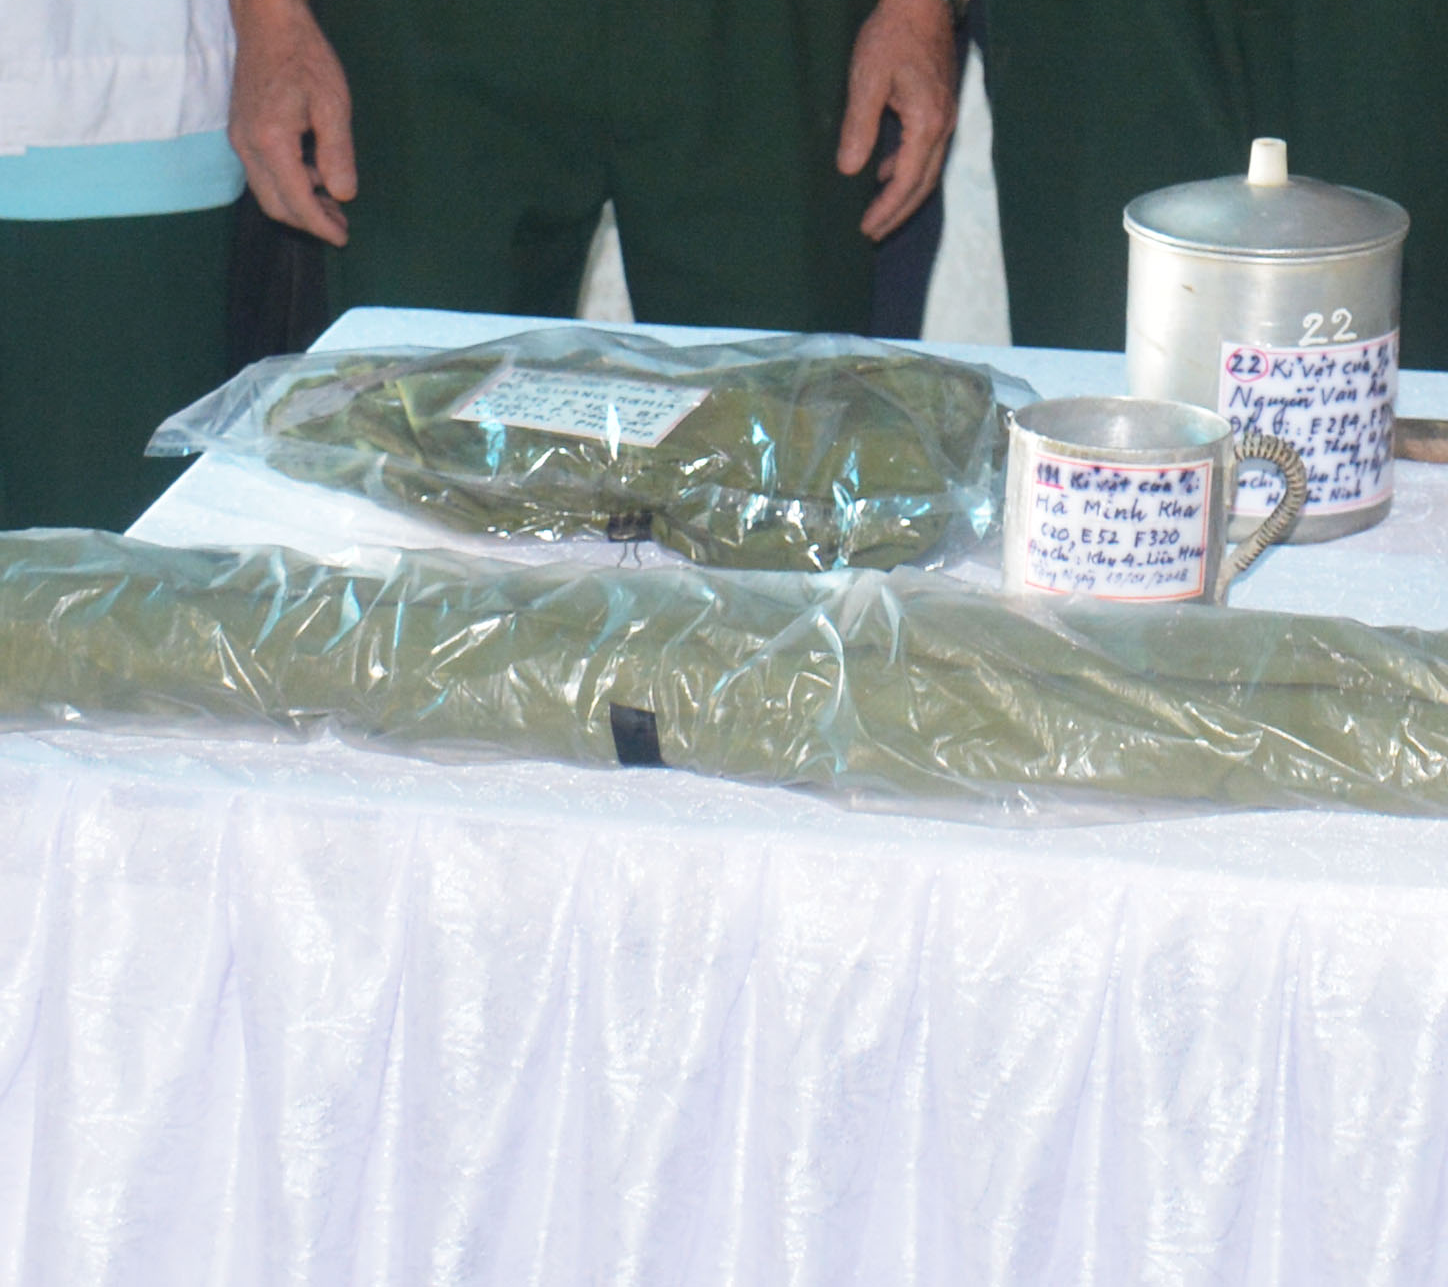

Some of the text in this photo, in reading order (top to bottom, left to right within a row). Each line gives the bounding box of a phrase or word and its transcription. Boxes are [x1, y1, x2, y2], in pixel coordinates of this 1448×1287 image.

[1299, 308, 1357, 346] 22
[1230, 354, 1261, 373] 22
[1084, 498, 1147, 521] Minh
